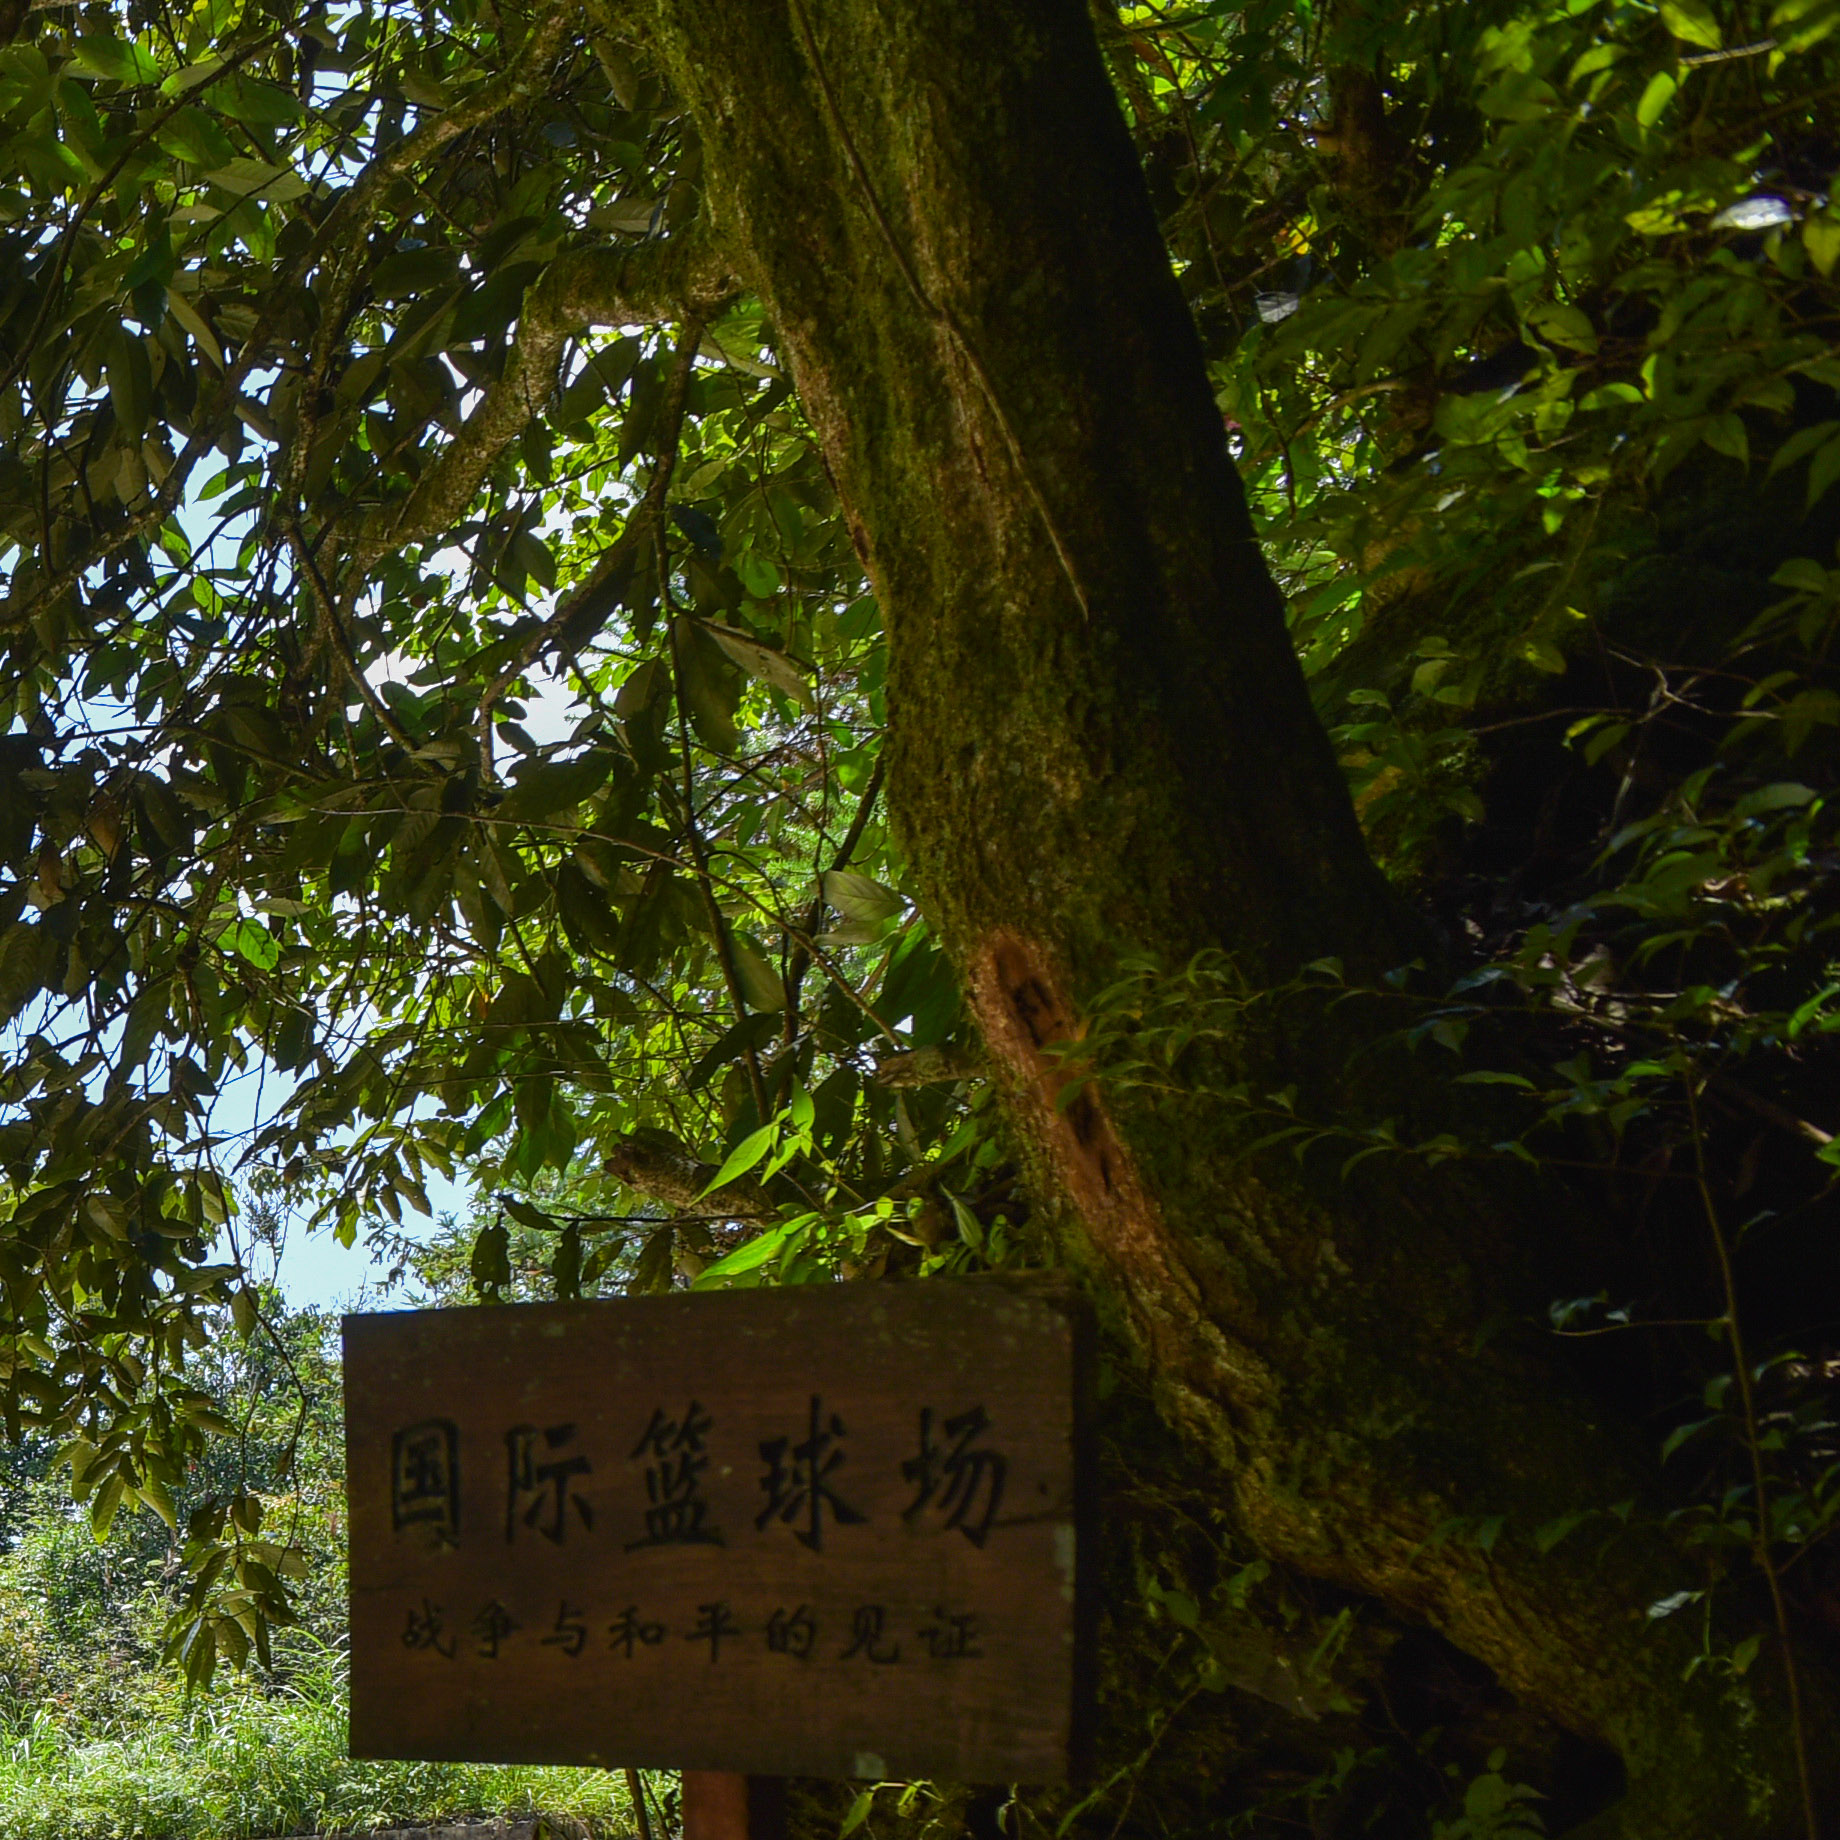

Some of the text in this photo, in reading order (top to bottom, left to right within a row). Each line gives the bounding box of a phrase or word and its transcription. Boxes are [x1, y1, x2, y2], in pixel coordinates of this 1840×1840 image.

[390, 1395, 1010, 1551] 国际篮球场
[400, 1599, 985, 1665] 战争与和平的见证
